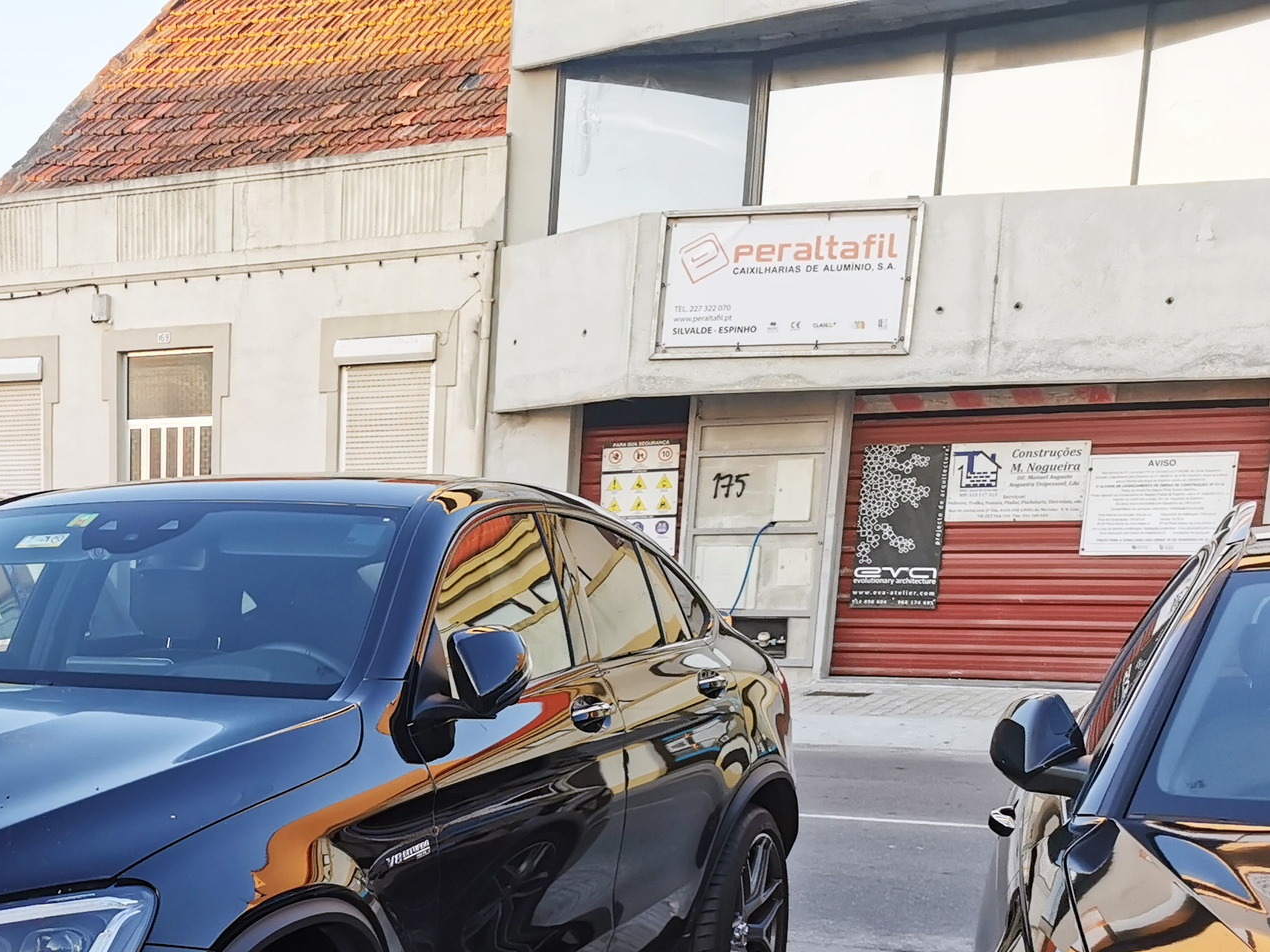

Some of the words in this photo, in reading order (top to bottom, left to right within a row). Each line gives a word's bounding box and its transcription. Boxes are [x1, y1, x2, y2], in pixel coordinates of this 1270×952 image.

[733, 233, 898, 263] peraltafil
[732, 265, 801, 275] CAIXILHARIAS
[805, 264, 819, 273] DE
[822, 262, 874, 272] ALUMÍNIO,
[877, 262, 897, 271] S.A.
[674, 305, 688, 313] TEL.
[704, 304, 717, 312] 322
[673, 314, 732, 323] www.peraltafil.pt
[672, 326, 713, 335] SILVALDE
[718, 325, 757, 334] ESPINHO
[662, 450, 670, 458] 10
[1012, 447, 1082, 459] Construções
[1010, 463, 1023, 473] M.
[1026, 462, 1081, 474] Nogueira
[1148, 459, 1176, 467] AVISO
[713, 472, 750, 499] 175
[937, 500, 945, 510] de
[934, 513, 944, 546] projecto
[854, 566, 938, 579] eva
